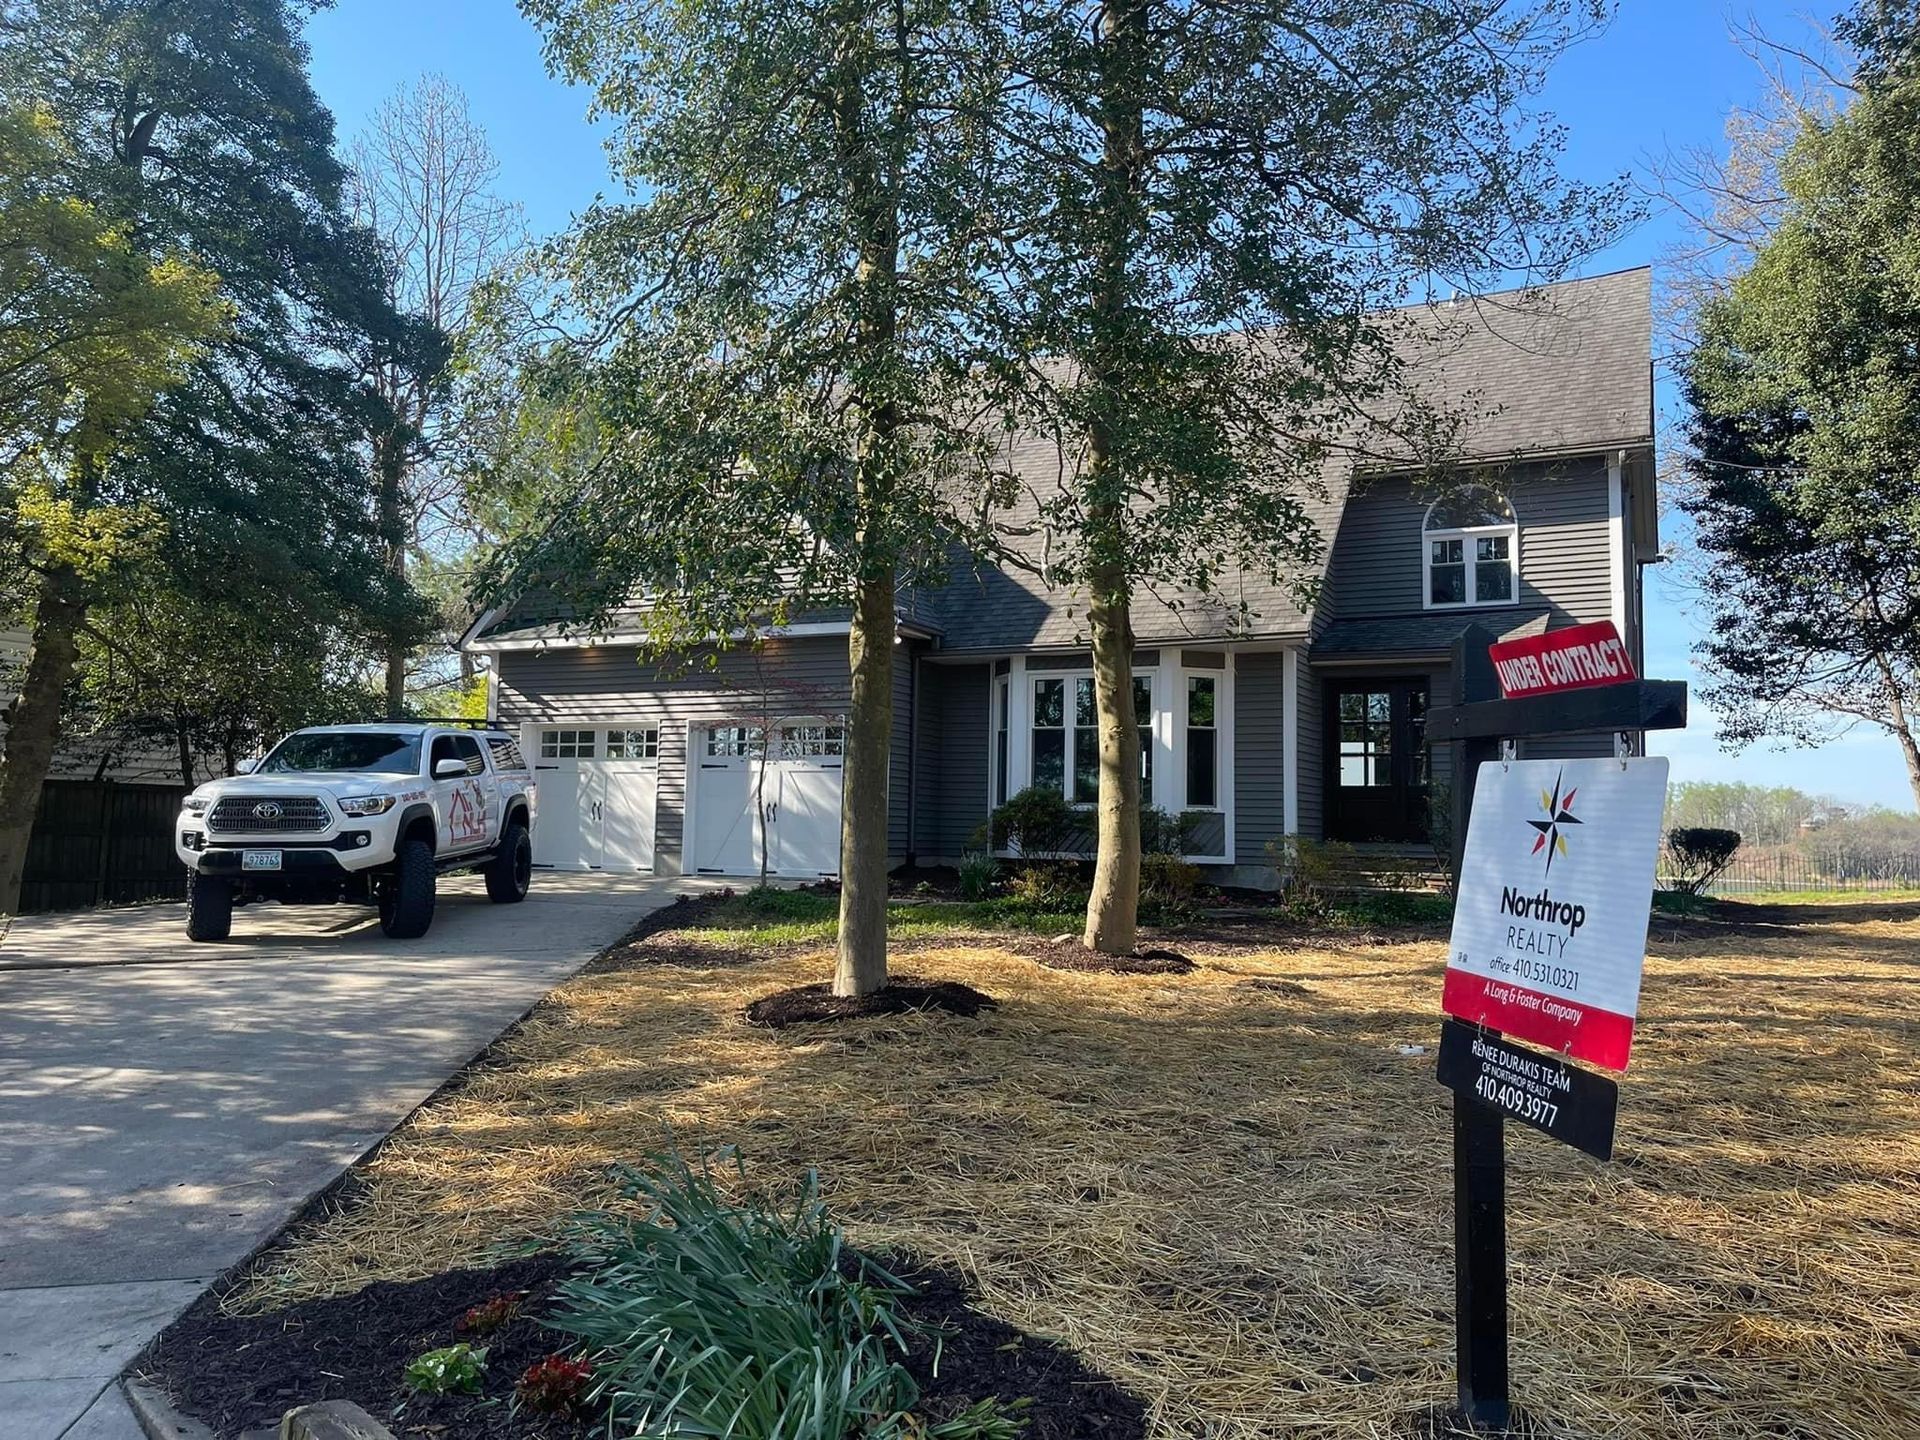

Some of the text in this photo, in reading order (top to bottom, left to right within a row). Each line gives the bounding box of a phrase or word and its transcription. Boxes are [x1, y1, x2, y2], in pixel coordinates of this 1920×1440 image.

[1495, 638, 1628, 692] UNDER CONTRACT
[1500, 885, 1586, 937] Northrop
[1506, 926, 1569, 959] REALTY
[1489, 956, 1511, 972] office:
[1512, 958, 1580, 991] 410.531.0321
[1483, 981, 1583, 1026] A Long & Foster Company
[1471, 1040, 1571, 1093] RENEE DURAKIS TEAM
[1482, 1061, 1553, 1099] OF NORTHROP REALTY
[1475, 1074, 1558, 1128] 410.409.3977
